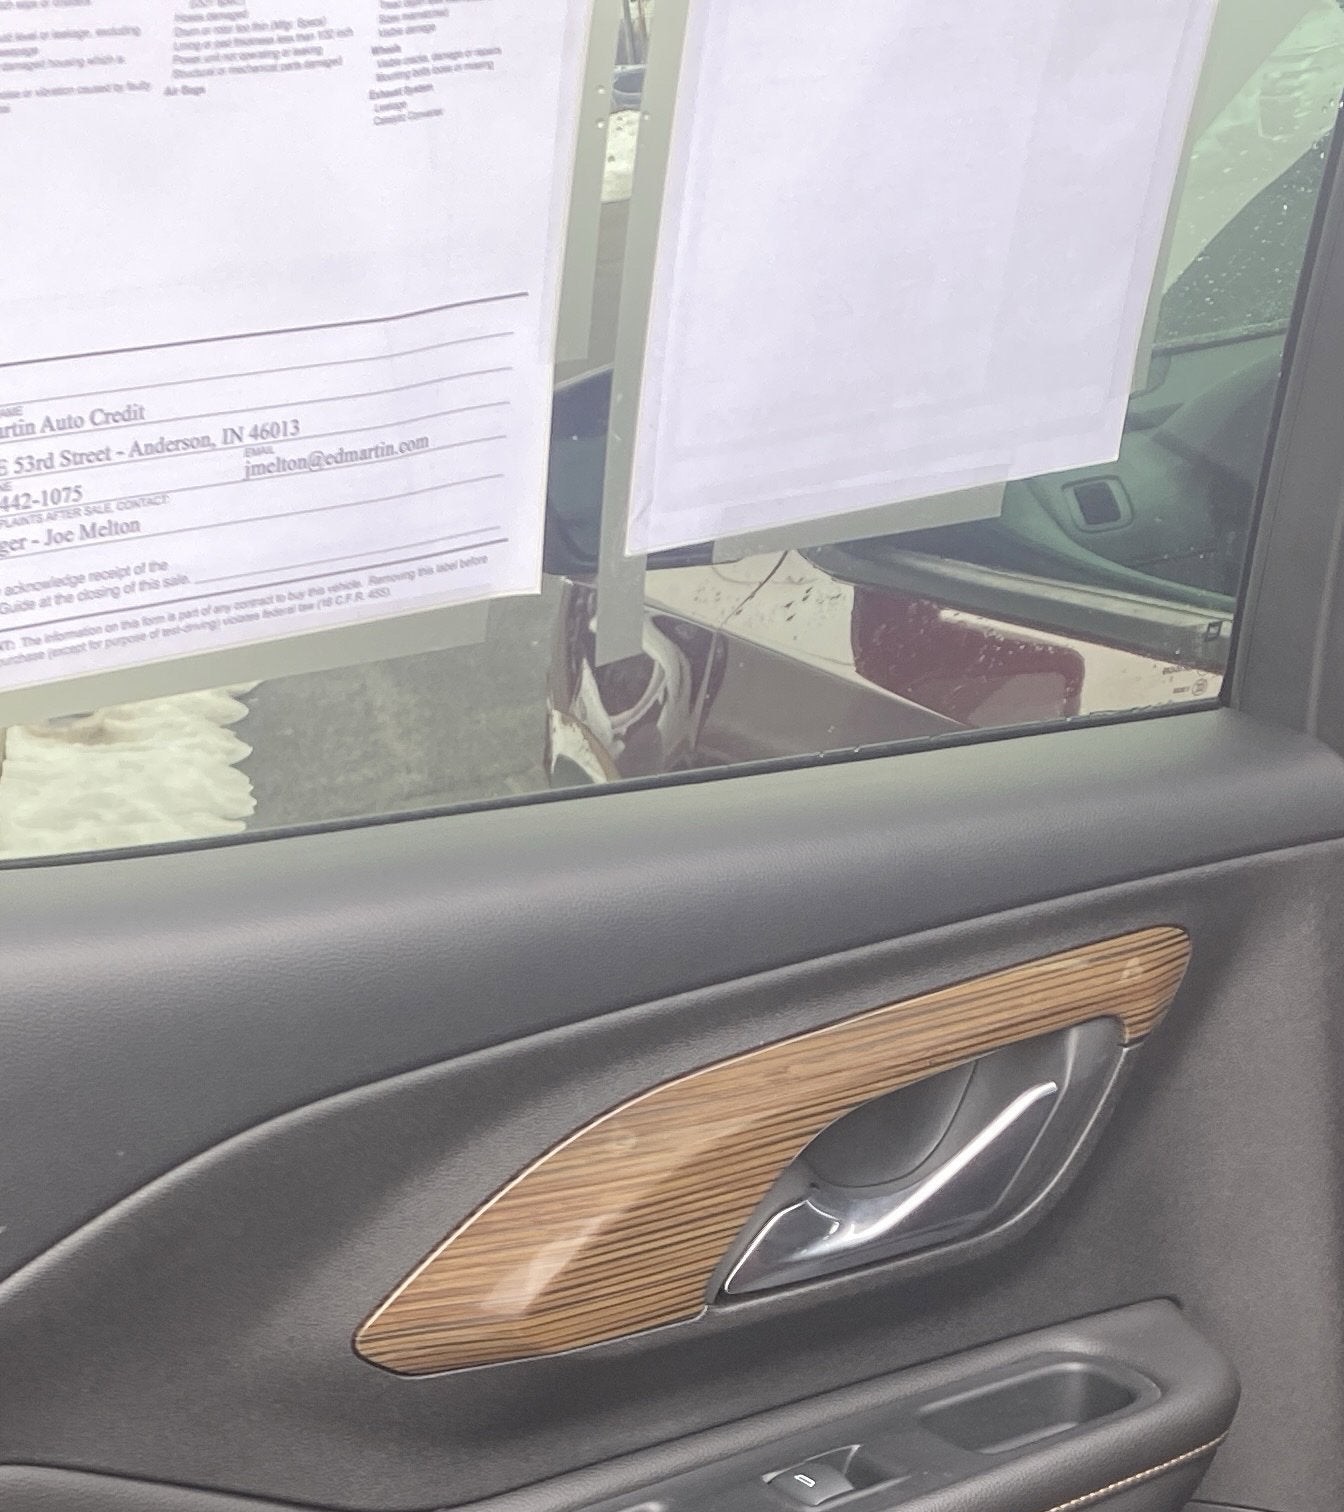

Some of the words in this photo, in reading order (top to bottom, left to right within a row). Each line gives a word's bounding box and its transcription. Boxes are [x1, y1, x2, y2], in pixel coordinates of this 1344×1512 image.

[40, 415, 84, 435] Auto
[89, 403, 145, 425] Credit
[14, 454, 55, 474] 53rd
[60, 447, 111, 468] Street
[128, 435, 217, 458] Anderson,
[222, 427, 244, 445] IN
[248, 419, 301, 441] 46013
[243, 435, 429, 480] jmelton@edmartin.com
[44, 527, 74, 547] Joe
[78, 518, 141, 541] Melton
